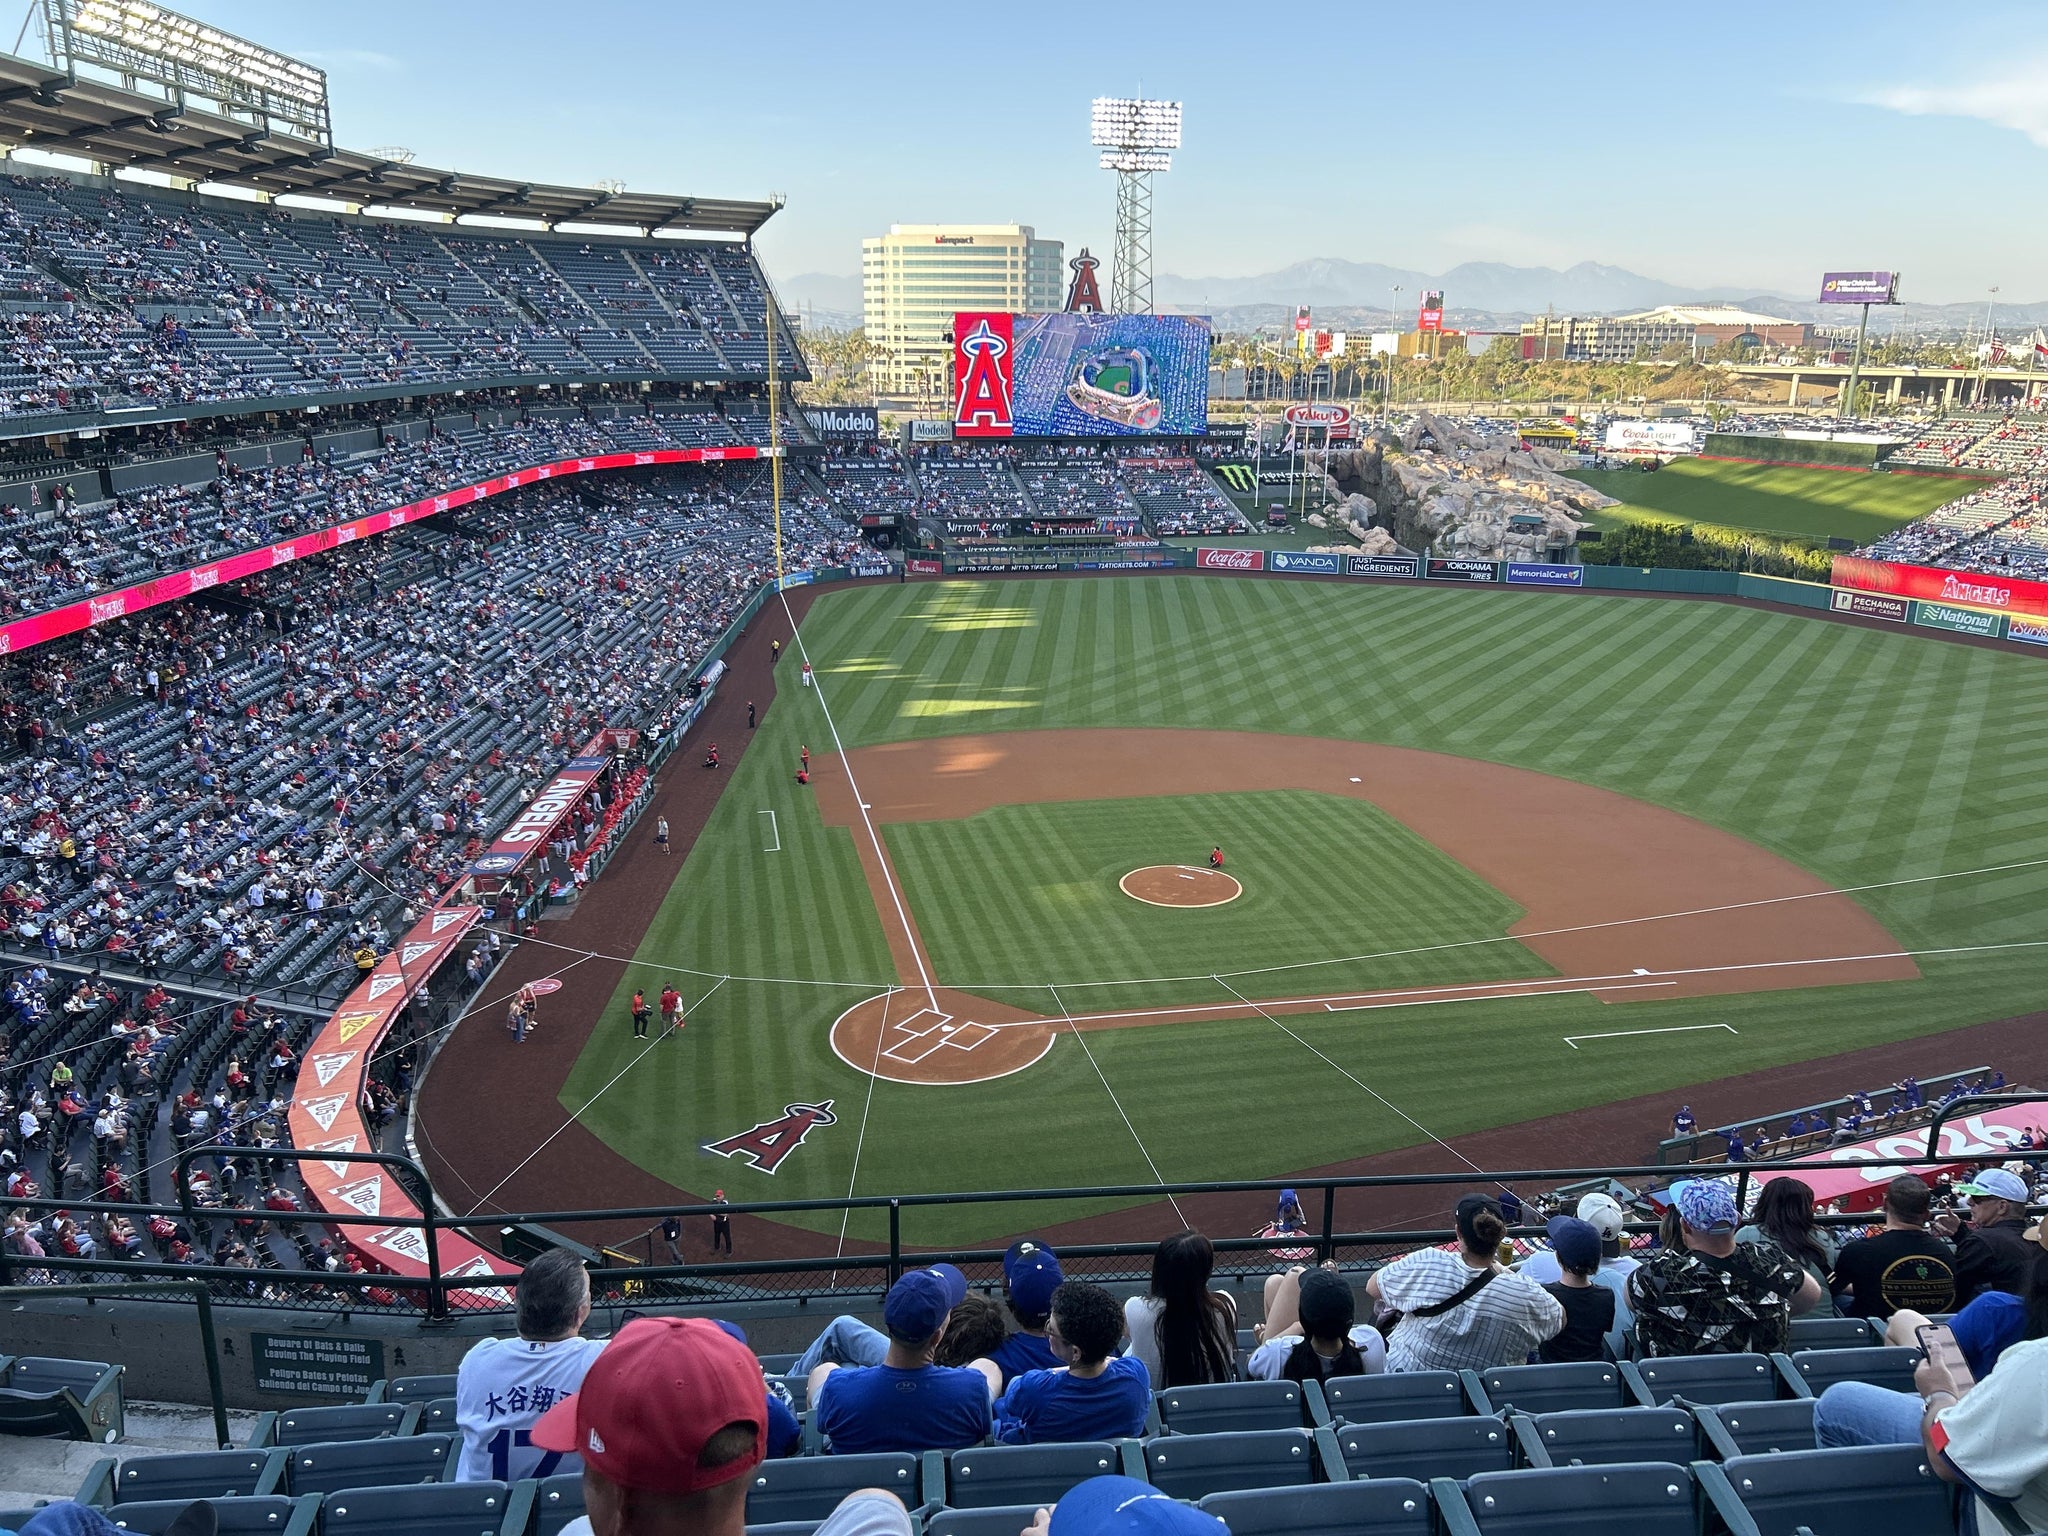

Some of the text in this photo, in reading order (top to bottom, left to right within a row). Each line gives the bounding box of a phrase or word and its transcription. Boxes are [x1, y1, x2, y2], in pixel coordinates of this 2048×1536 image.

[822, 411, 875, 431] Modelo
[917, 423, 948, 436] Modelo
[1622, 428, 1650, 439] Coors
[1098, 561, 1149, 569] 714TICKETS.COM
[1206, 550, 1255, 568] Coca-Cola
[1289, 557, 1334, 567] VANDA
[859, 567, 884, 576] Modelo
[1354, 564, 1411, 573] INGREDIENTS
[1446, 562, 1492, 571] YOKOHAMA
[1470, 572, 1492, 580] TIRES
[1511, 569, 1568, 579] MemorialCare
[1941, 575, 2011, 606] ANGELS
[1853, 604, 1902, 617] RESORT CASINO
[1854, 597, 1902, 611] PECHANGA
[1938, 607, 1994, 628] National
[1967, 625, 1989, 634] Rental
[501, 778, 586, 843] ANGELS
[350, 1187, 376, 1204] '08
[392, 1231, 421, 1250] '09
[268, 1338, 366, 1352] Beware Of Bats & Balls
[265, 1349, 371, 1365] Leaving The Playing Field
[270, 1368, 368, 1383] Peligro Bates y Pelotas
[259, 1379, 370, 1395] Saliendo del Campo de Jue
